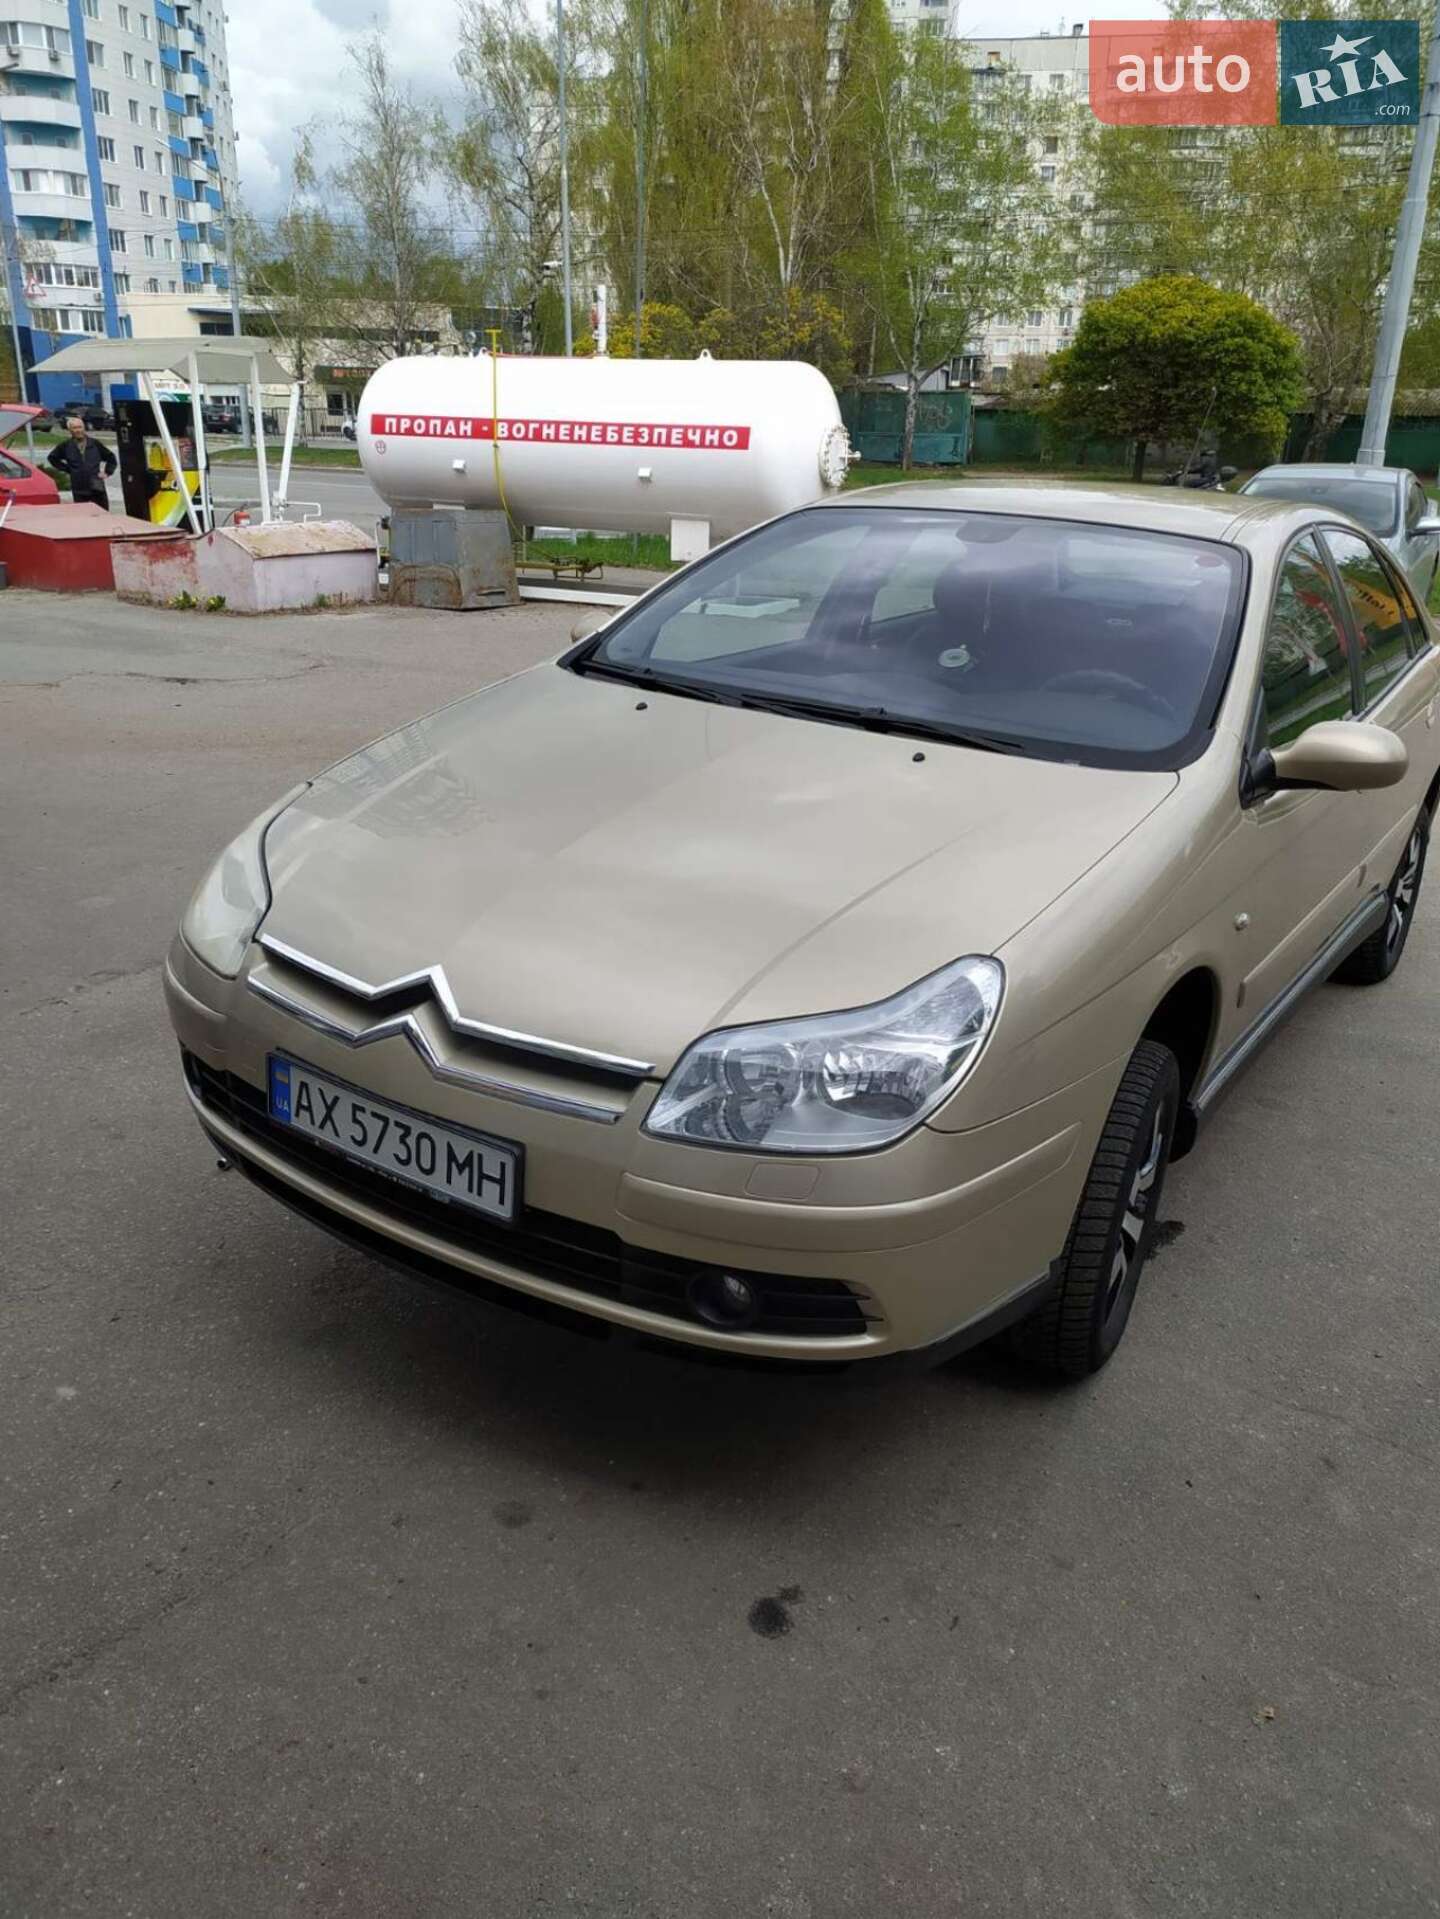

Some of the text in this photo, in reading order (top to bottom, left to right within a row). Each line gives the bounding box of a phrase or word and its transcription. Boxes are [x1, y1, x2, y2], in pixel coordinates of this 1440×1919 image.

[384, 416, 473, 437] ПРОПАН
[496, 421, 739, 447] ВОГНЕНЕБЕЗПЕЧНО
[275, 1096, 290, 1112] UA
[294, 1081, 341, 1138] AX
[349, 1102, 437, 1176] 5730
[446, 1141, 507, 1206] MH
